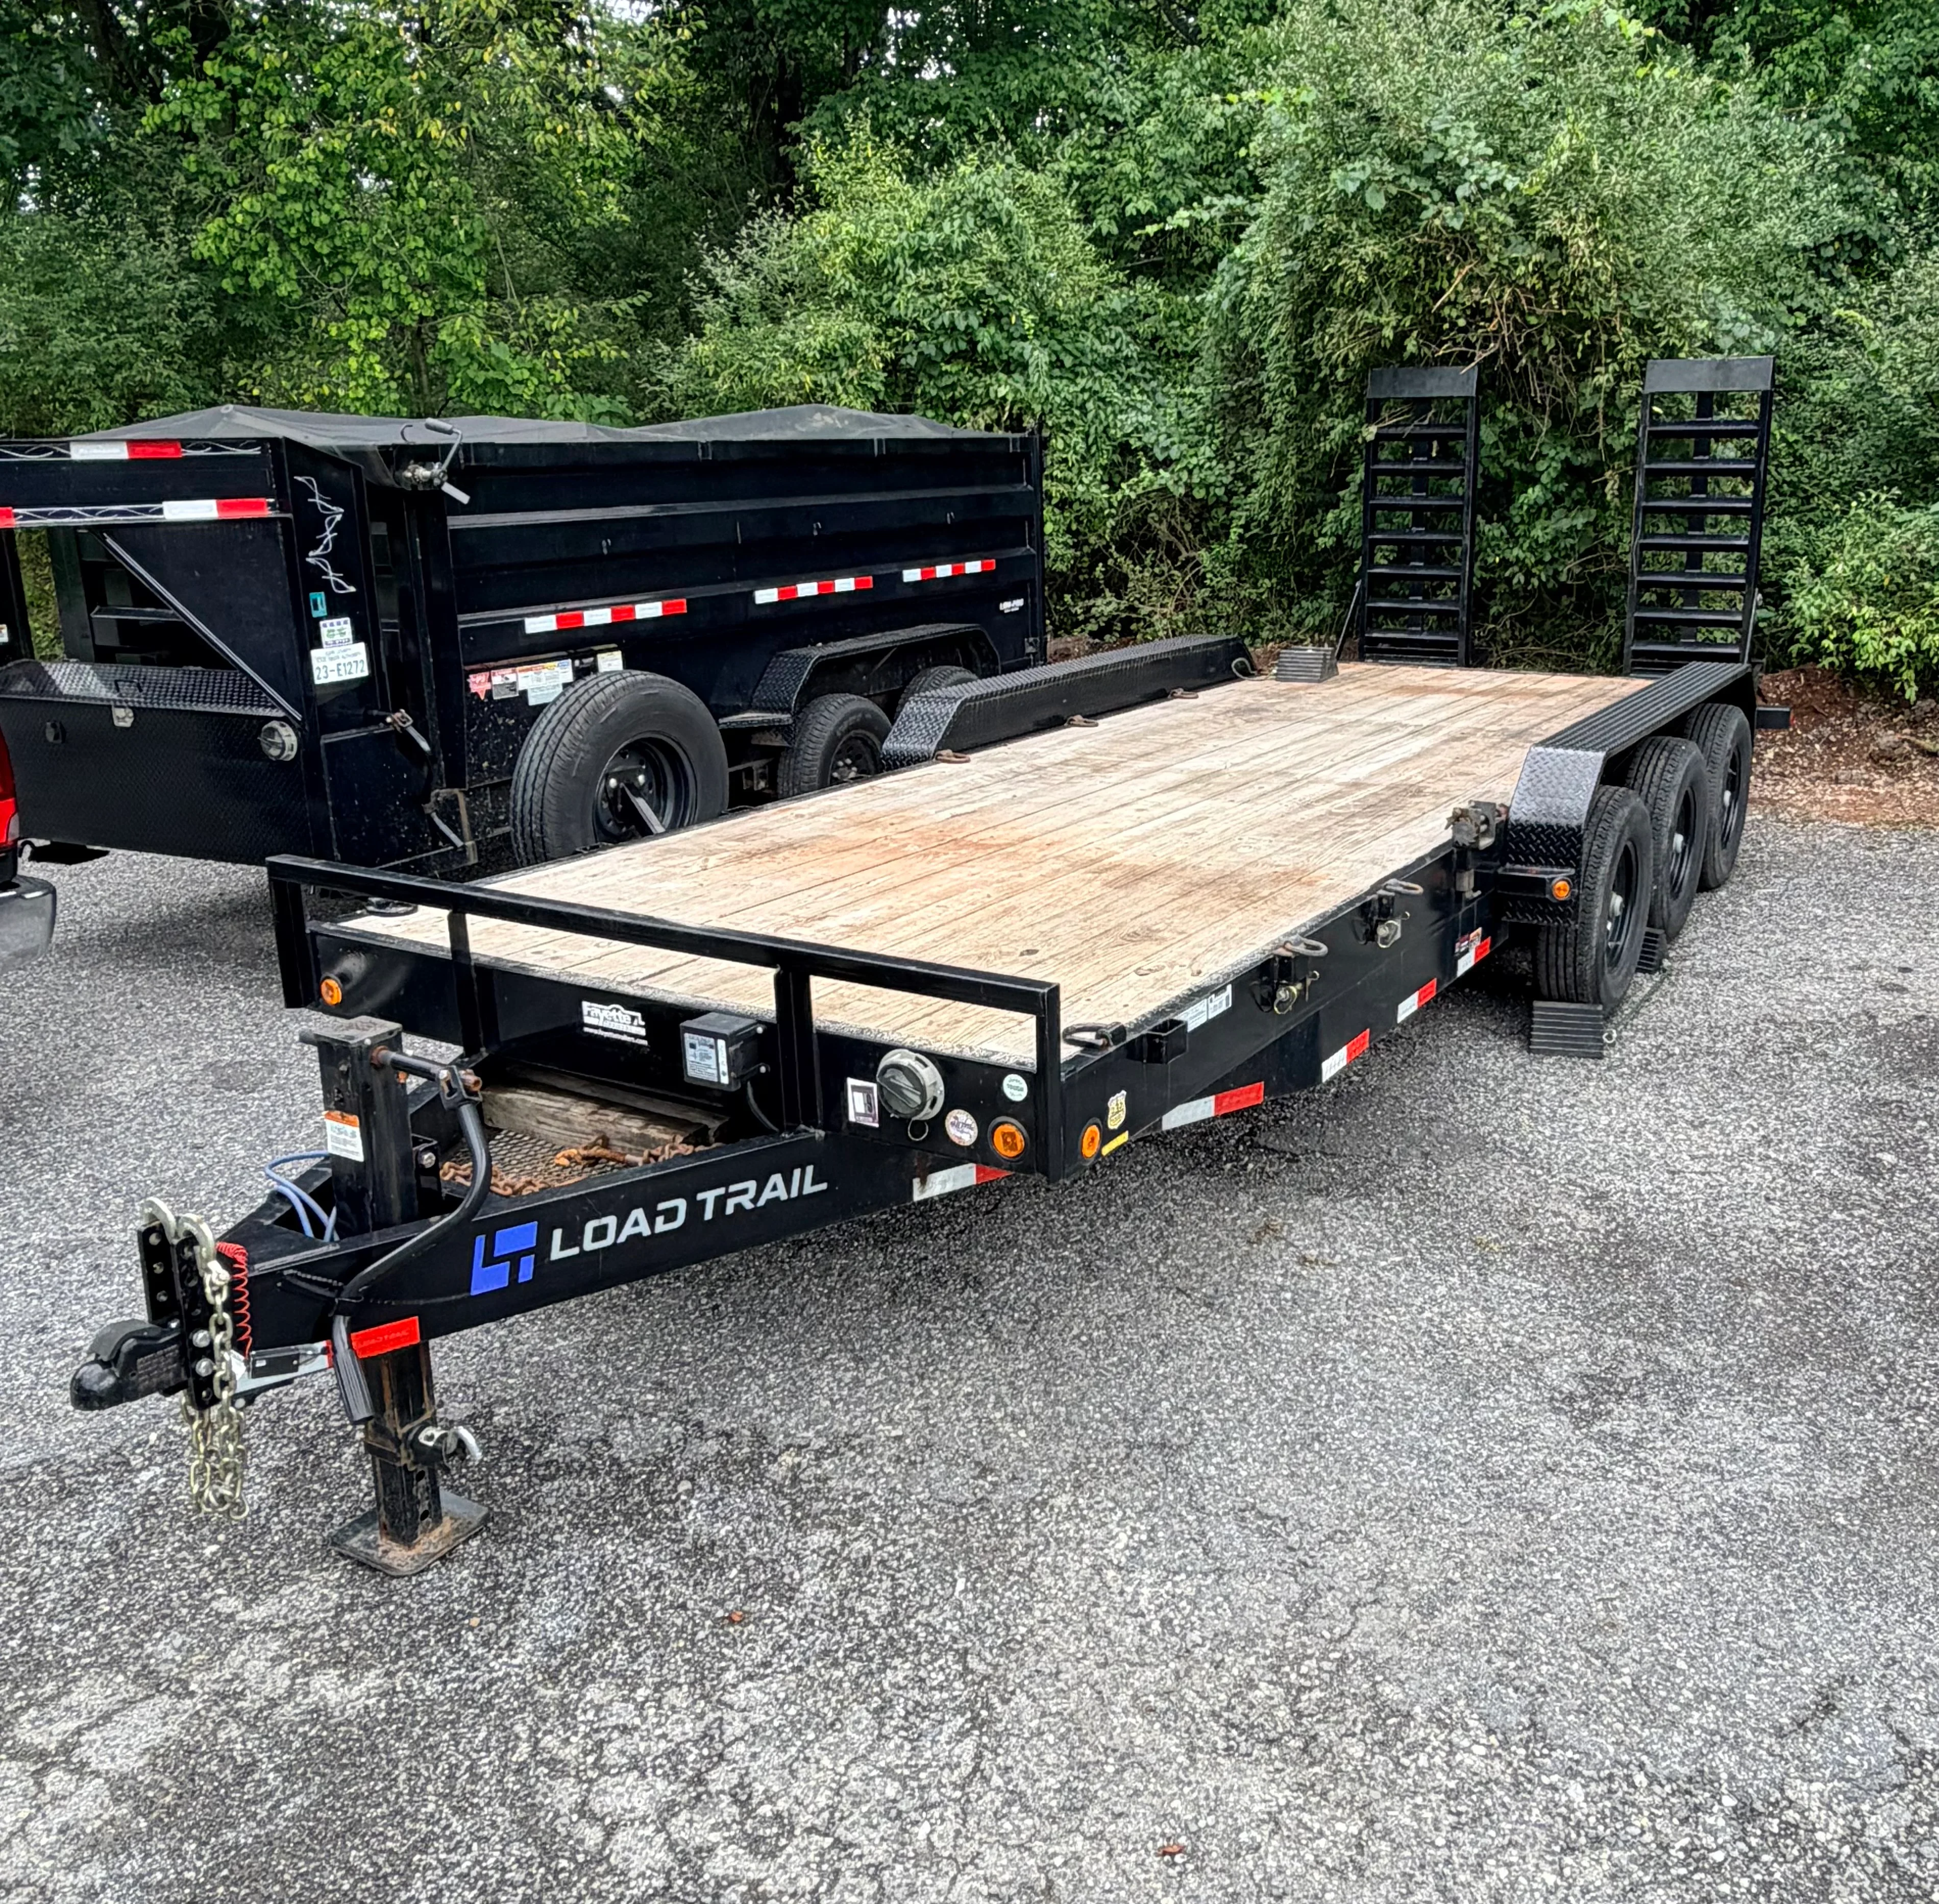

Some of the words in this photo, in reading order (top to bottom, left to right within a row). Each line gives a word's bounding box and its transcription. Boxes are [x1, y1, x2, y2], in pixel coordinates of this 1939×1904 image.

[315, 659, 366, 681] 23-E1272
[582, 1000, 632, 1026] Fayette
[550, 1198, 687, 1261] LOAD
[696, 1164, 828, 1221] TRAIL
